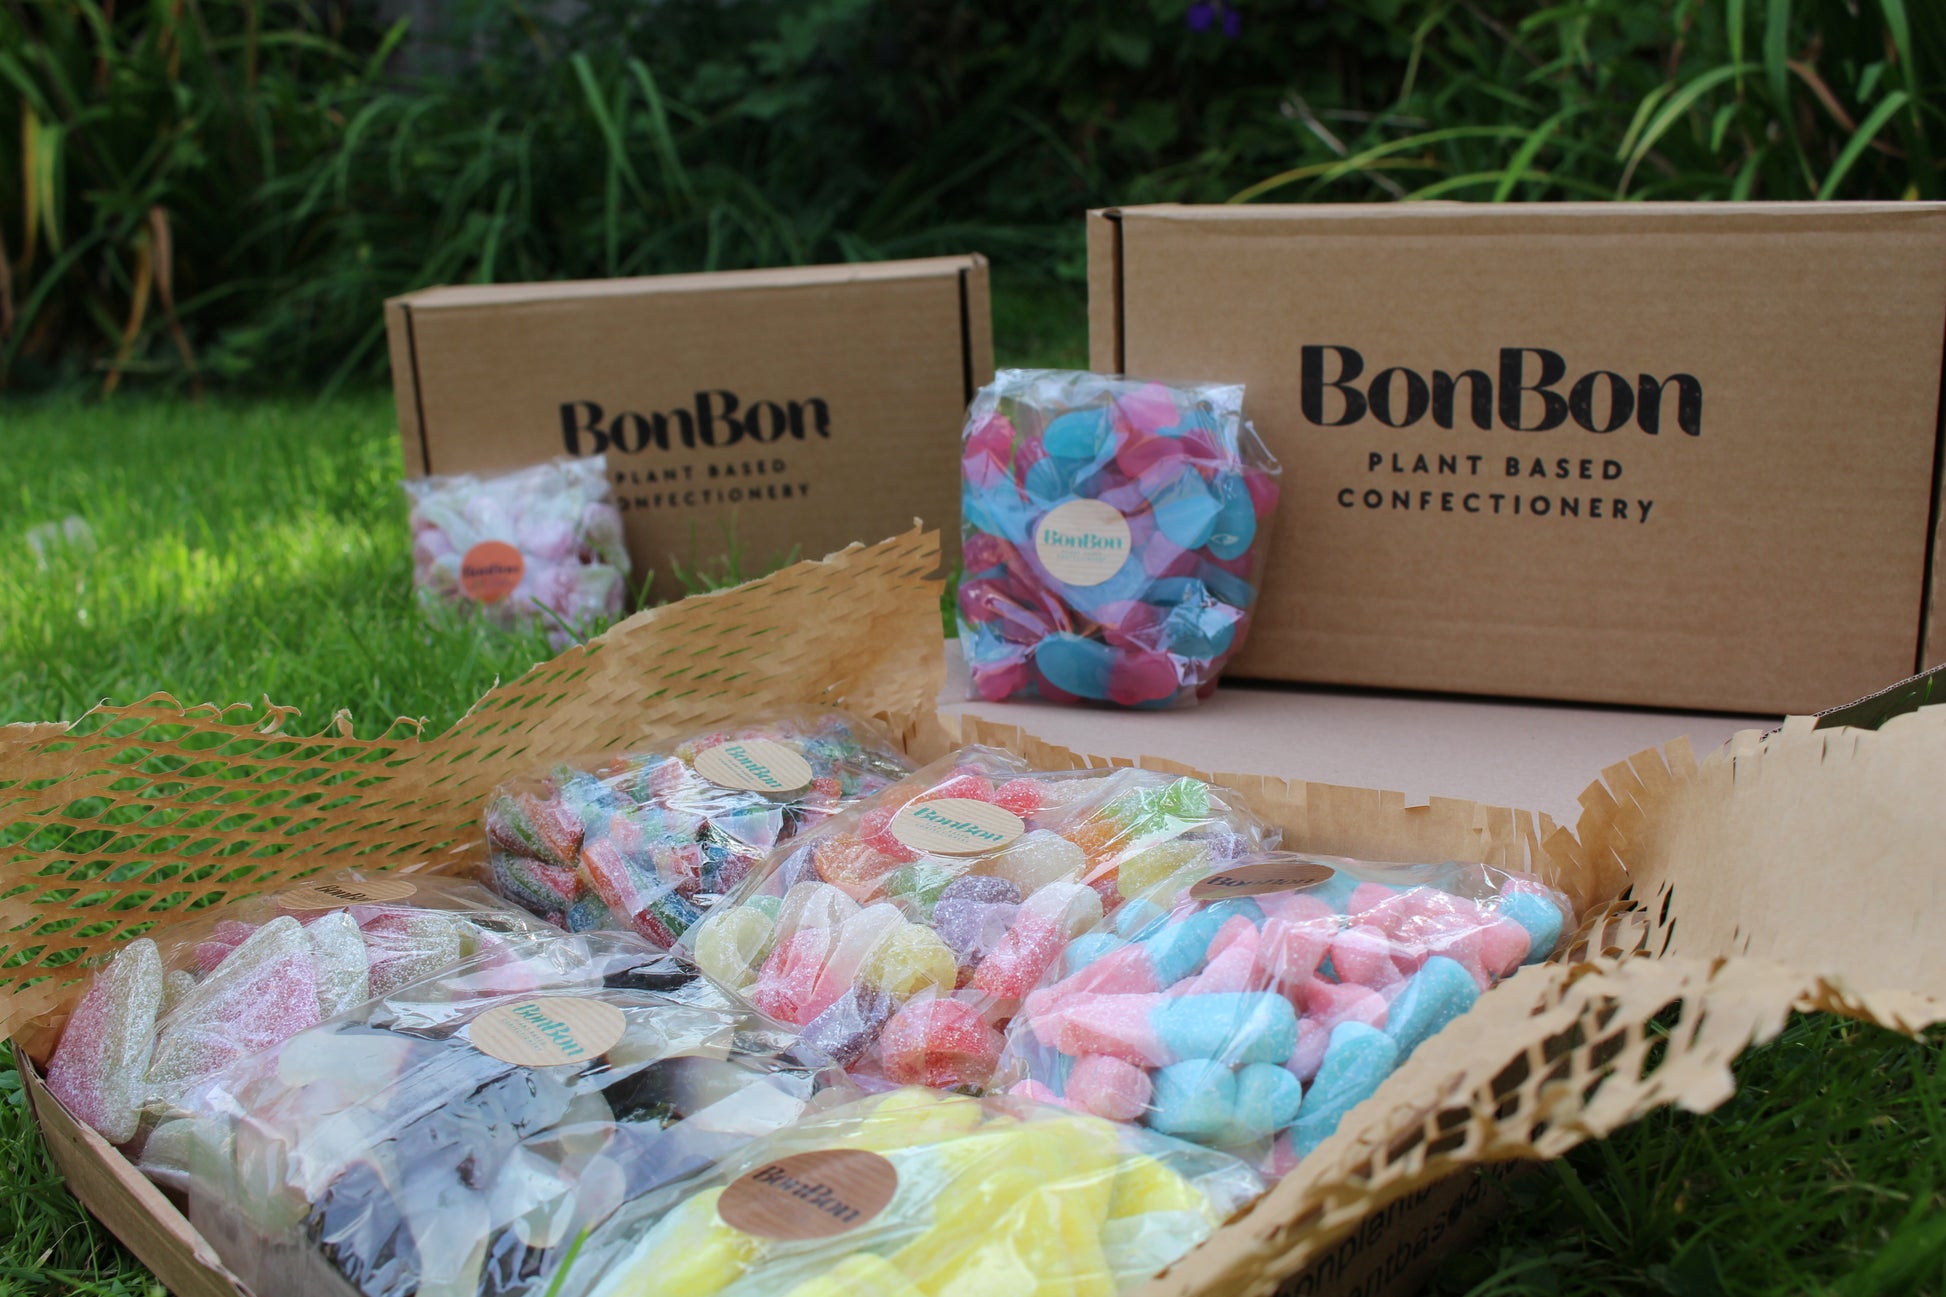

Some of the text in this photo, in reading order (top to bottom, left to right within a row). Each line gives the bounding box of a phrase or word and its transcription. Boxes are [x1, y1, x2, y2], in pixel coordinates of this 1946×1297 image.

[1300, 345, 1703, 437] BonBon
[559, 389, 831, 458] BonBon
[614, 458, 787, 486] PLANT BASED
[1368, 452, 1624, 481] PLANT BASED
[616, 483, 811, 513] ONFECTIONERY
[1337, 487, 1654, 523] CONFECTIONERY
[1043, 529, 1123, 550] BonBon
[725, 745, 782, 788] BonBon
[914, 807, 1003, 841] BonBon
[512, 1003, 585, 1056] BonBon
[752, 1165, 861, 1223] BonBon
